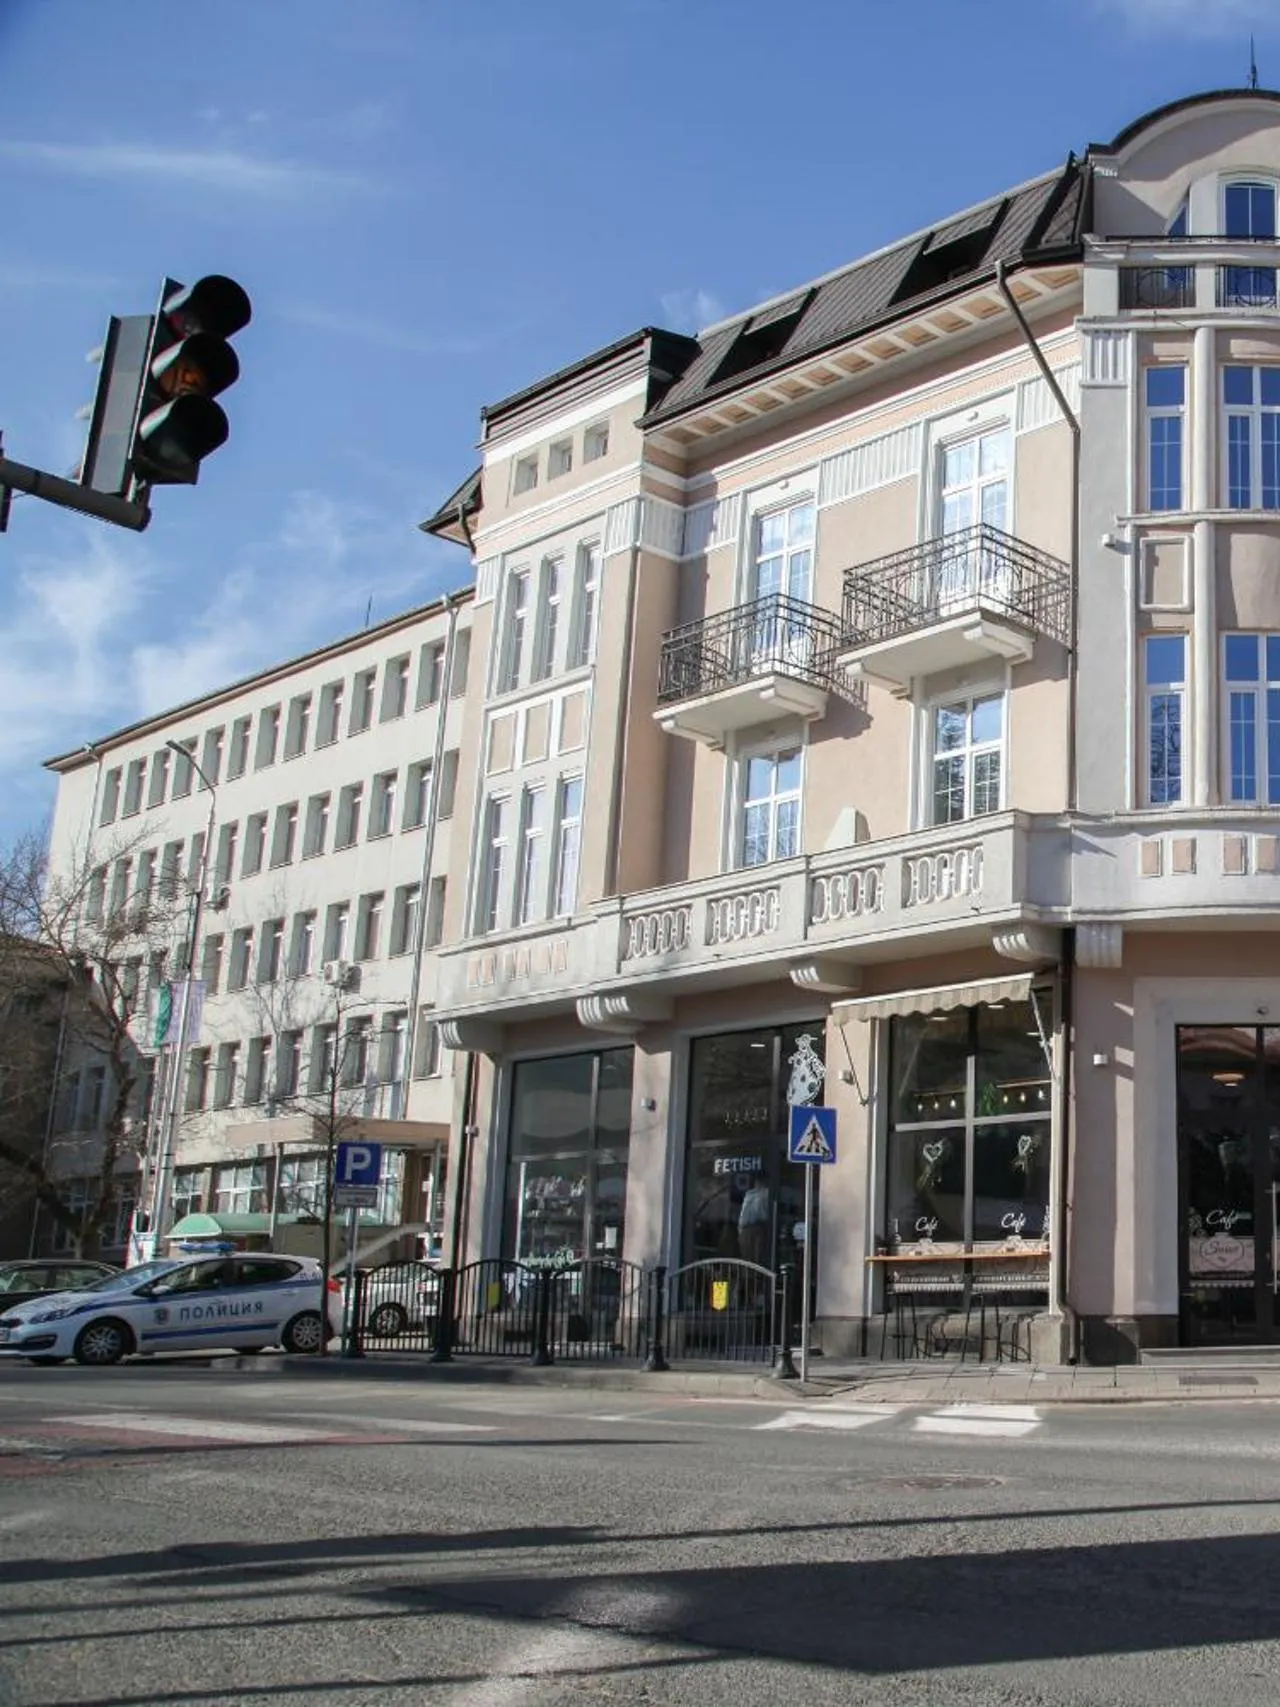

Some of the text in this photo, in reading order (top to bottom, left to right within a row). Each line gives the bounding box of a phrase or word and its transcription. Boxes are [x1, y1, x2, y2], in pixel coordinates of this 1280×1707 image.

[345, 1146, 371, 1180] P
[713, 1156, 762, 1174] FETISH
[180, 1301, 264, 1321] ПОЛИЦИЯ
